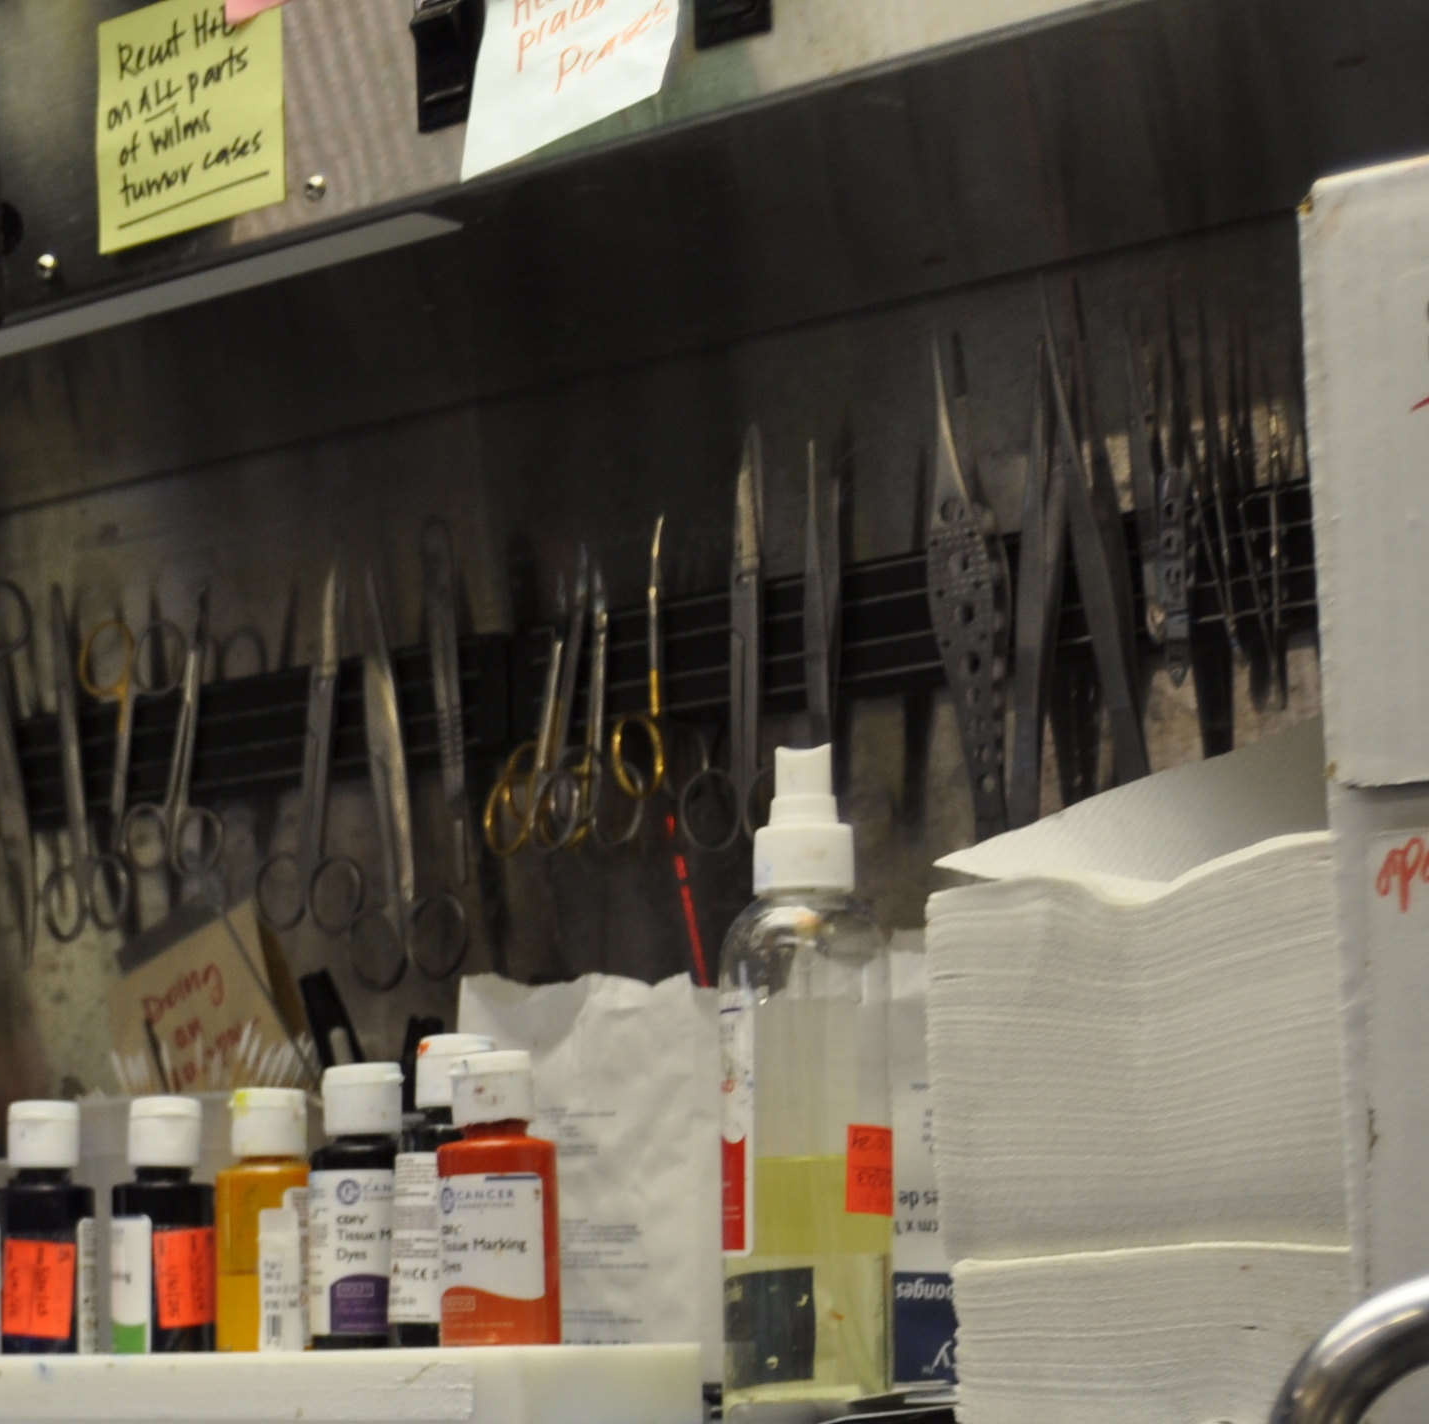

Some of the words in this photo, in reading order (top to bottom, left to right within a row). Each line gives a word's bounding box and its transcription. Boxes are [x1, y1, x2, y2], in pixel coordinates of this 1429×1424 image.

[107, 100, 133, 131] on
[139, 78, 182, 113] ALL
[188, 46, 248, 104] parts
[119, 130, 140, 167] of
[119, 162, 193, 207] tumor
[202, 130, 262, 171] cases
[457, 1189, 515, 1199] CANCER
[336, 1229, 376, 1241] Tissue
[473, 1237, 528, 1254] Marking
[336, 1249, 368, 1264] Dyes
[895, 1276, 955, 1301] ponges
